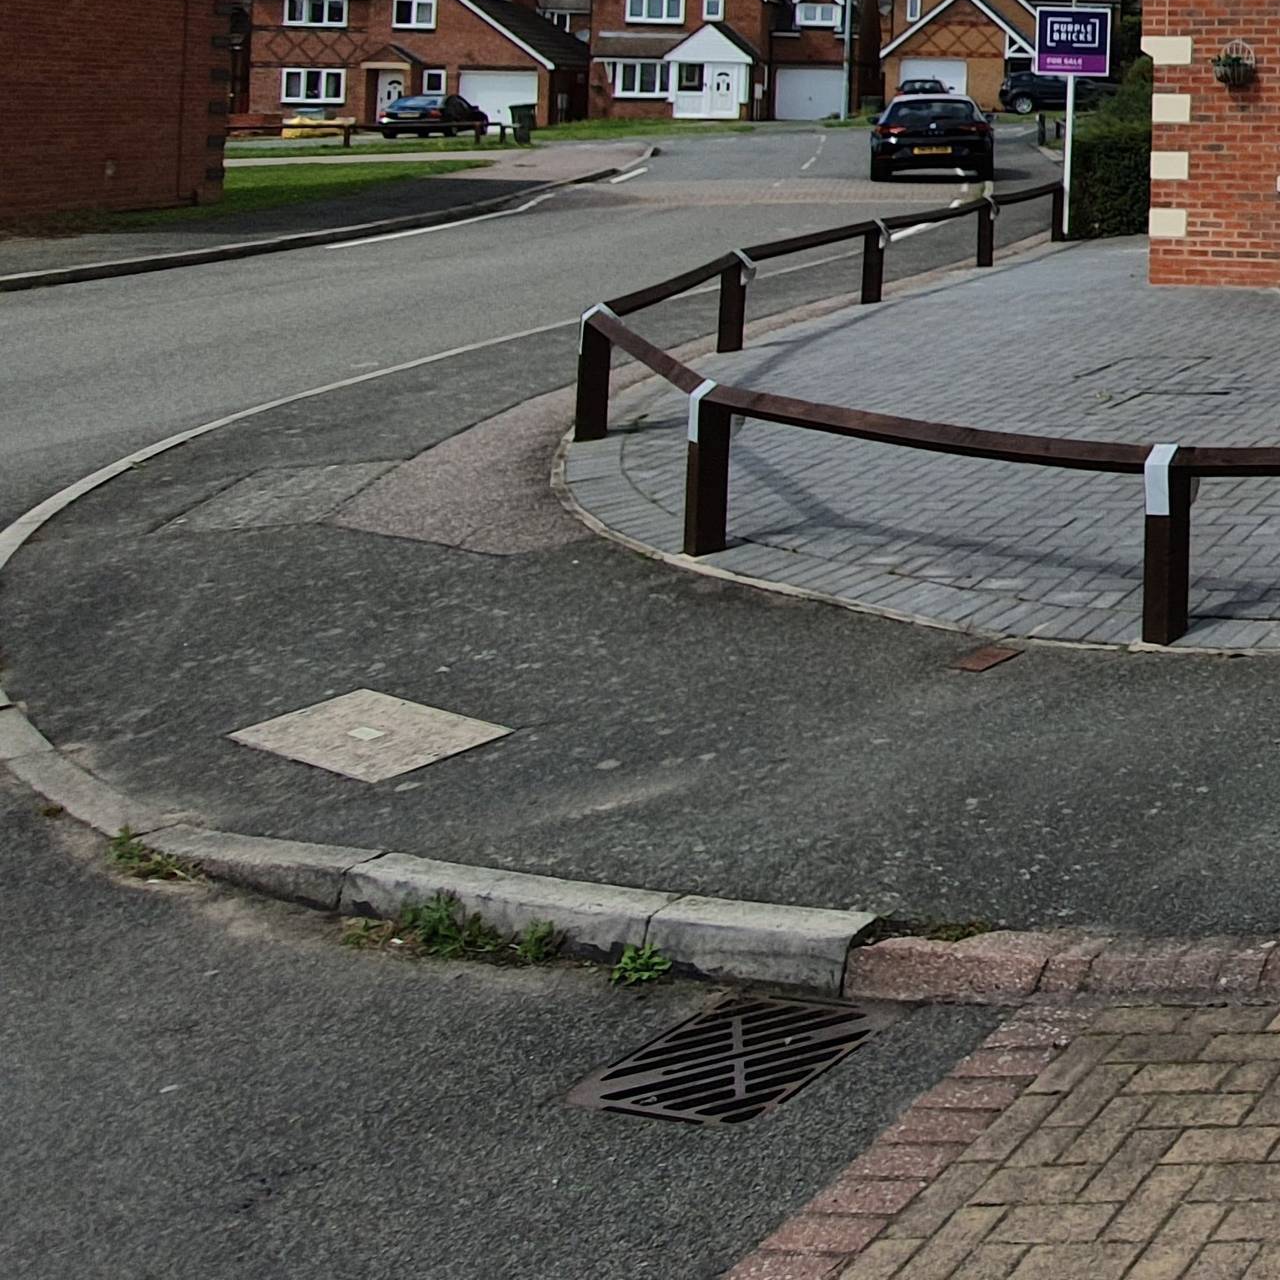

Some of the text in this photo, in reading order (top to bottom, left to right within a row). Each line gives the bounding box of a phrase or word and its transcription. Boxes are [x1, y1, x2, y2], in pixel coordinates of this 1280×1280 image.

[1053, 23, 1092, 32] PURPLE
[1053, 32, 1092, 41] BRICKS
[1046, 57, 1062, 65] FOR
